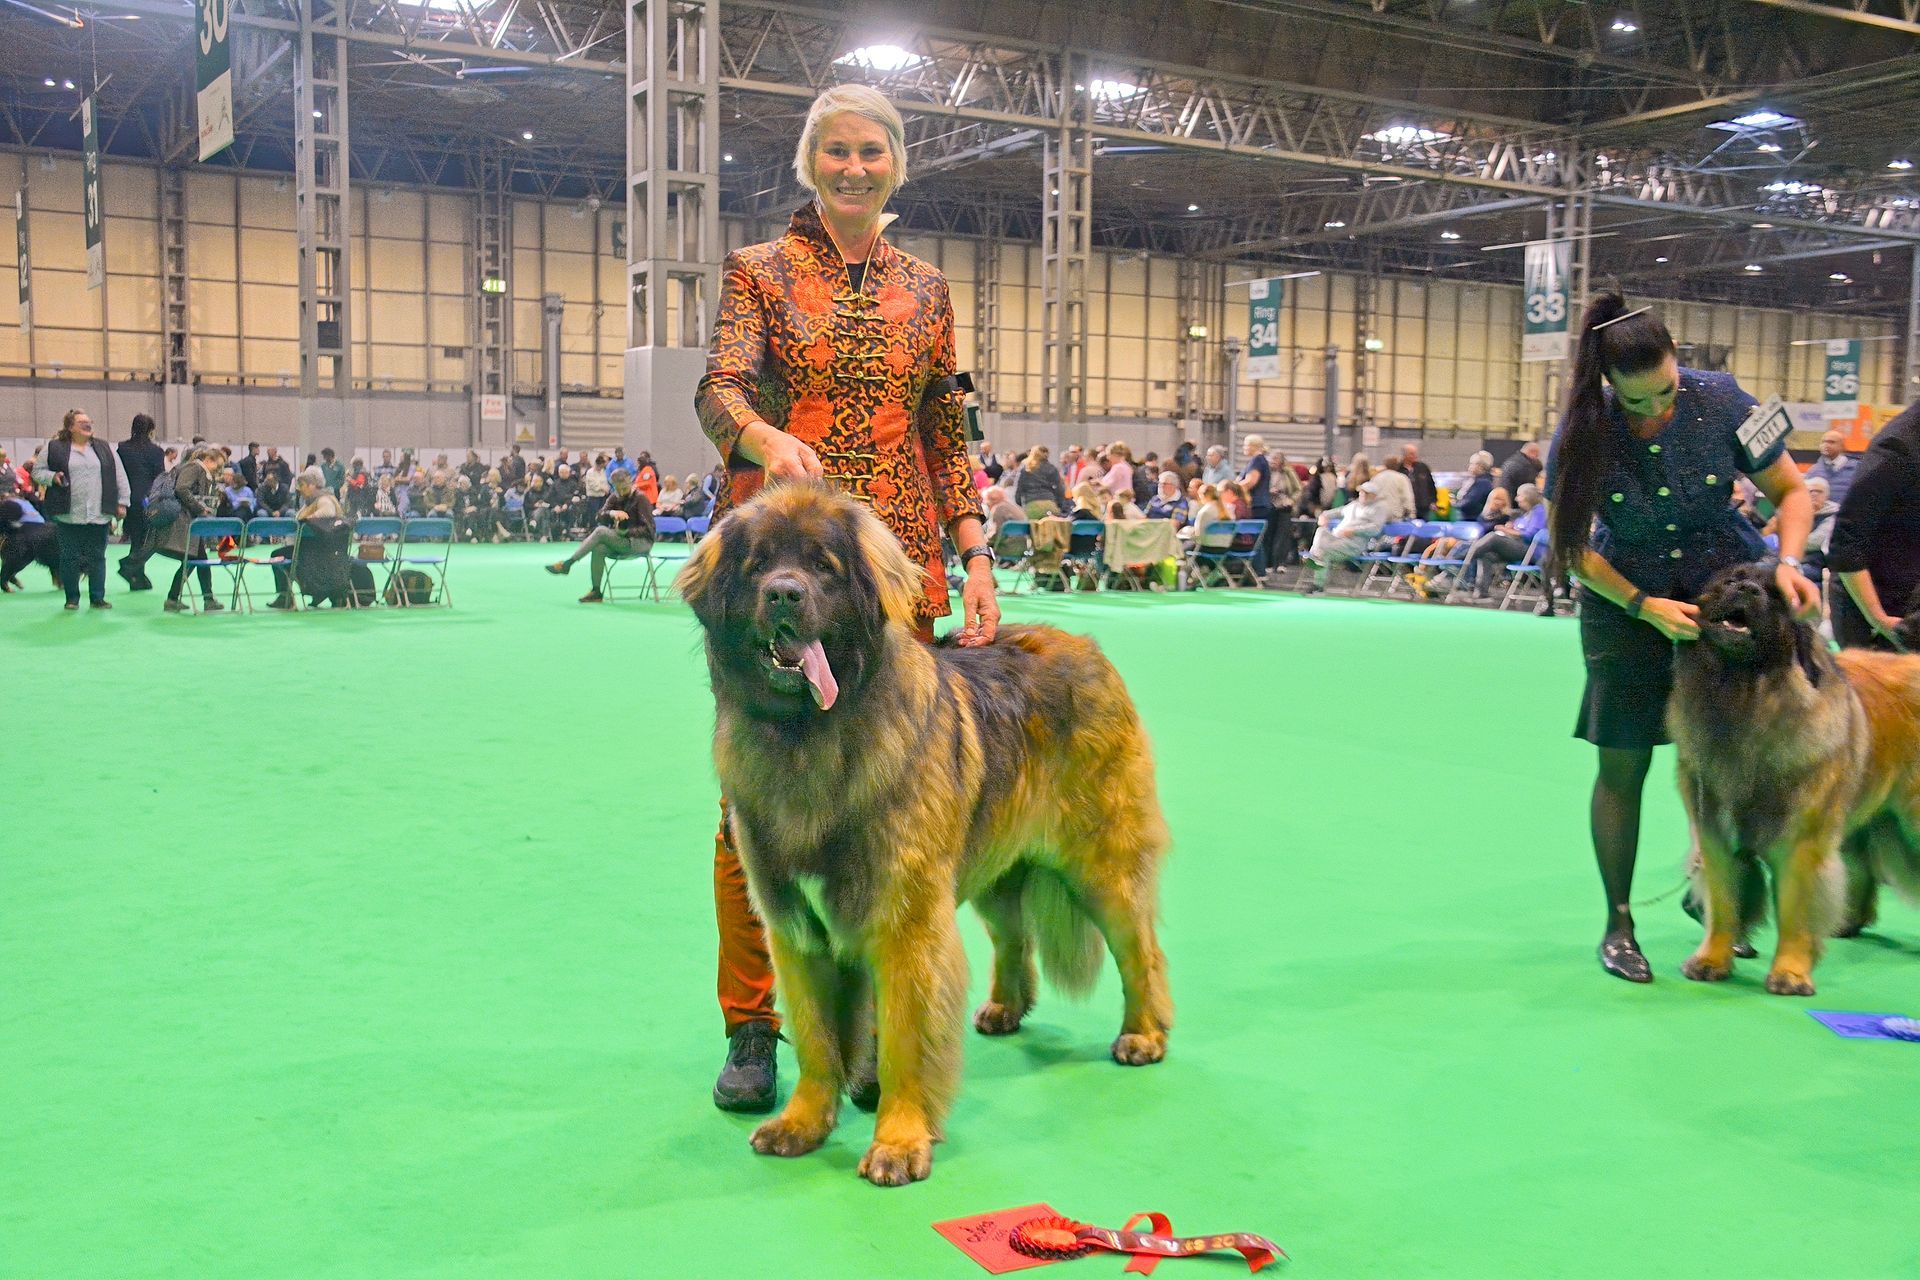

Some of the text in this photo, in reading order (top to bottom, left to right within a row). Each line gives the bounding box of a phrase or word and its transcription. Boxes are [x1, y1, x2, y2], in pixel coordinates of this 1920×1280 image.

[200, 0, 229, 55] 30
[87, 180, 99, 229] 31
[1254, 306, 1276, 321] Ring
[1527, 293, 1566, 324] 33
[1251, 322, 1277, 348] 34
[1826, 374, 1858, 395] 36
